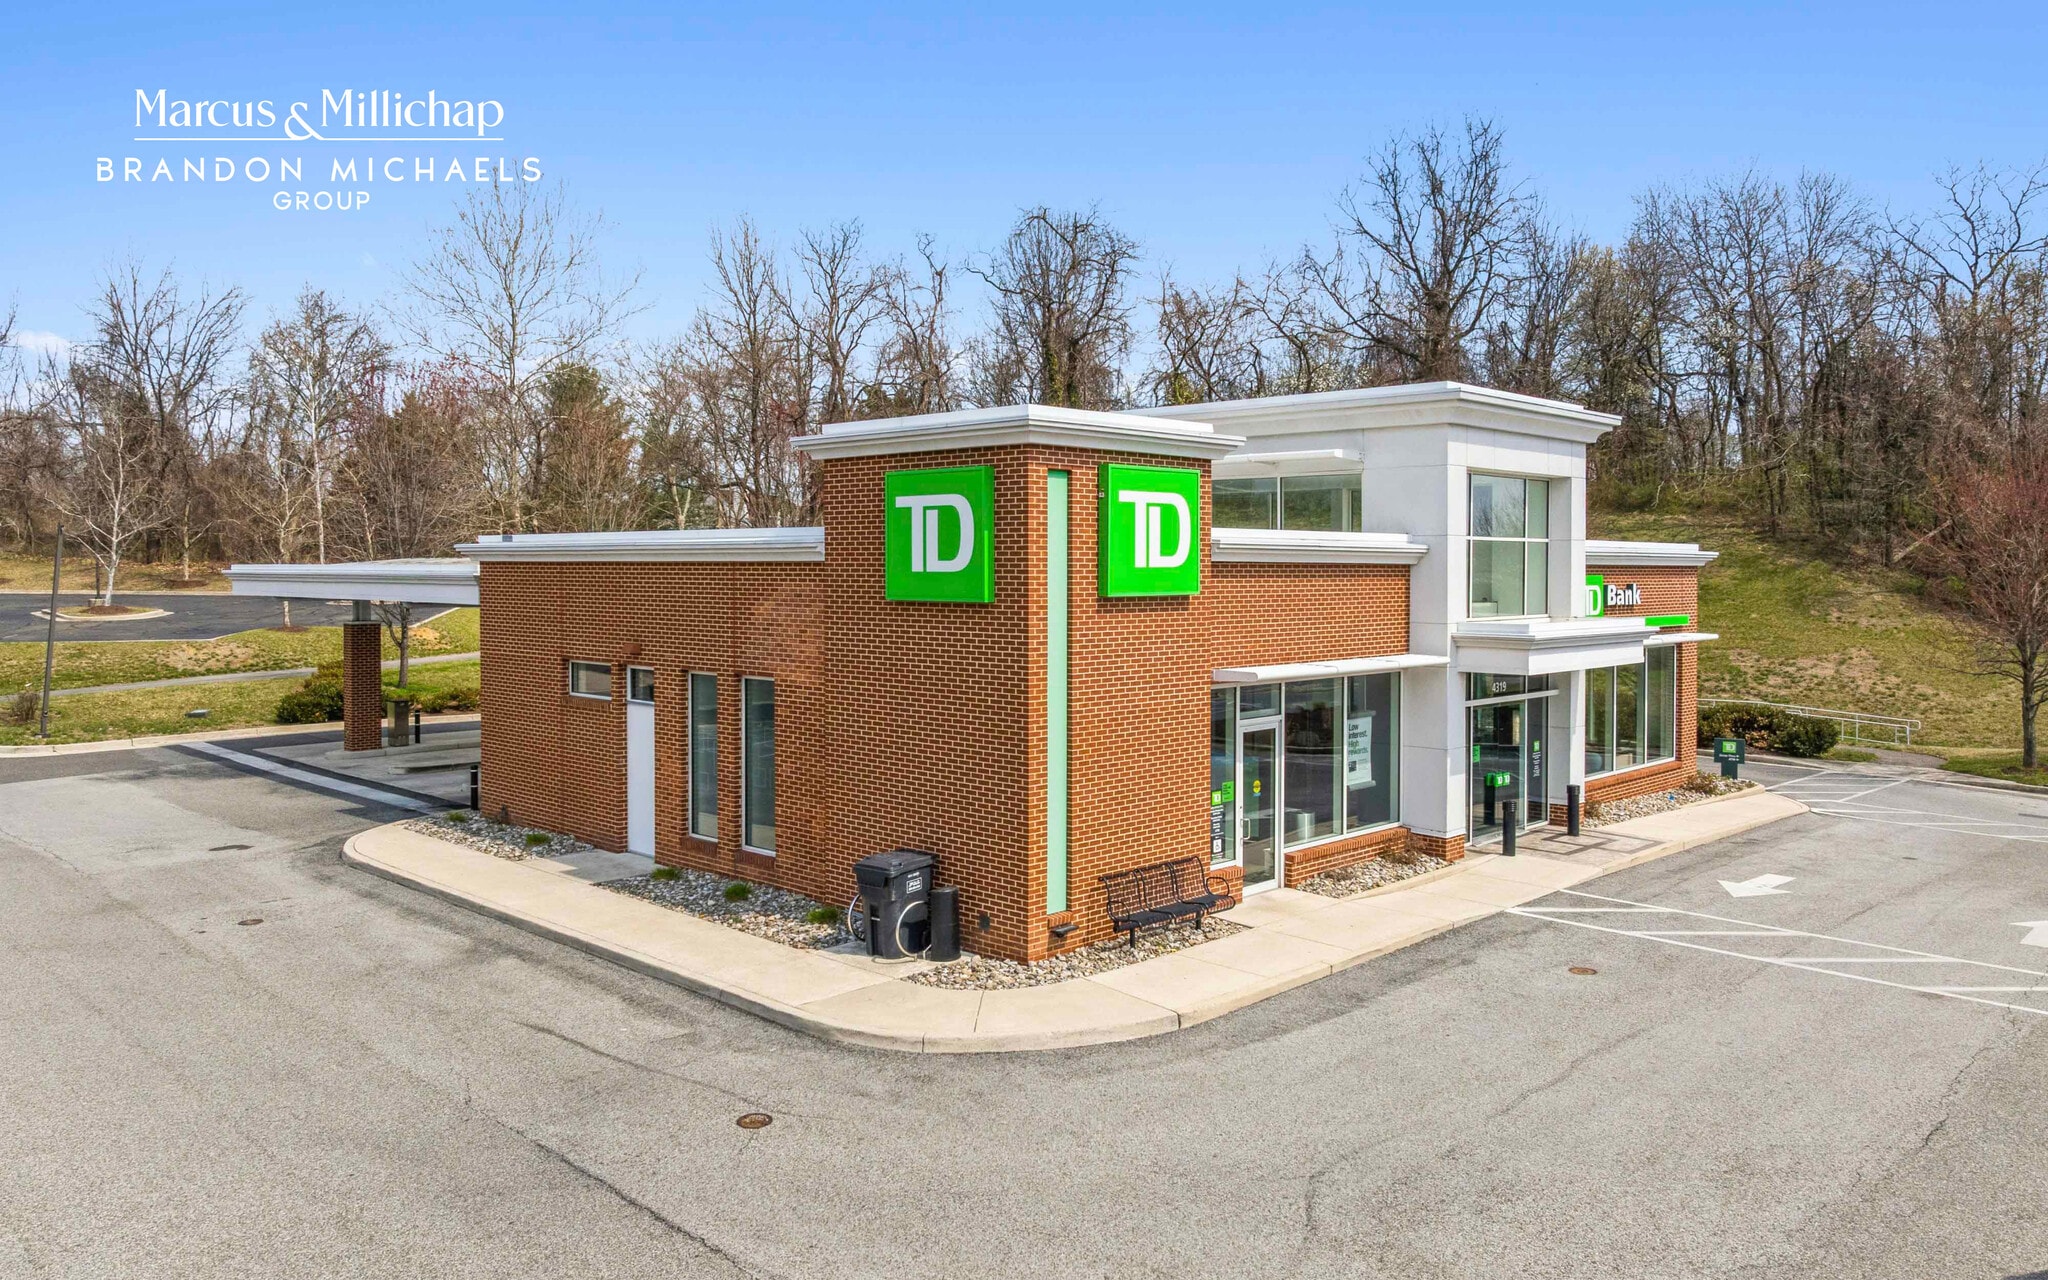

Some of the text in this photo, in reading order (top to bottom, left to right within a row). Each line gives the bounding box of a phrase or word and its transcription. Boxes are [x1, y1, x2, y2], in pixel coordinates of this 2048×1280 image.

[895, 493, 975, 572] TD
[1118, 489, 1192, 568] TD
[1607, 583, 1642, 606] Bank
[1491, 681, 1507, 693] 4319
